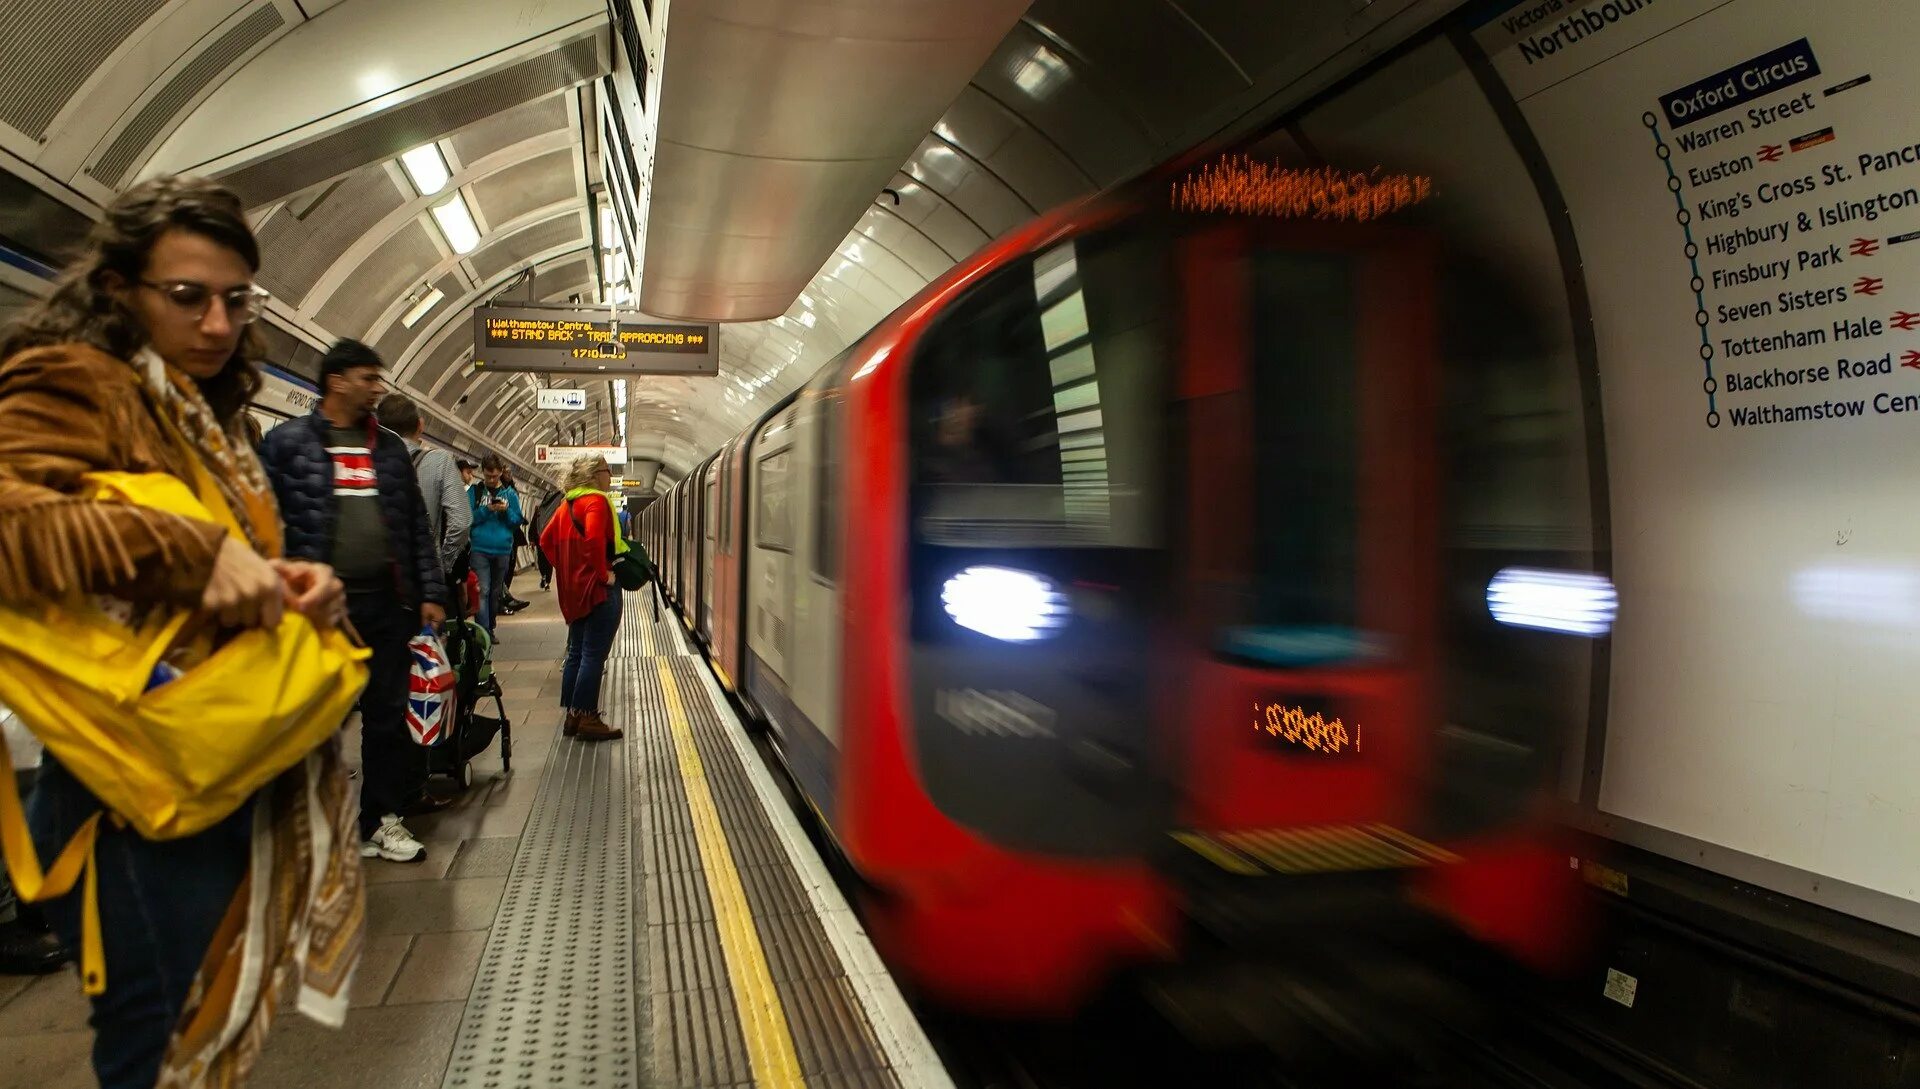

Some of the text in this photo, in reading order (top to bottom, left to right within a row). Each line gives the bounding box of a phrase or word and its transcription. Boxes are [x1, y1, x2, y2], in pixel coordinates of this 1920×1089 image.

[1518, 0, 1652, 65] Northbou
[1670, 55, 1809, 118] Oxford Circus
[1676, 92, 1815, 153] Warren Street
[1688, 155, 1753, 187] Euston
[1698, 192, 1752, 221] King's
[1757, 175, 1816, 204] Cross
[1821, 163, 1852, 187] St.
[1706, 187, 1919, 255] Highbury & Islington
[1712, 244, 1843, 290] Finsbury Park
[486, 318, 593, 331] 1 Walthamstow Central
[1717, 285, 1848, 324] Seven Sisters
[511, 328, 545, 340] STAND
[548, 329, 574, 341] BACK
[619, 331, 684, 345] APPROACHING
[1721, 316, 1883, 358] Tottenham Hale
[1726, 352, 1892, 393] Blackhorse Road
[1728, 391, 1920, 427] Walthamstow Cen
